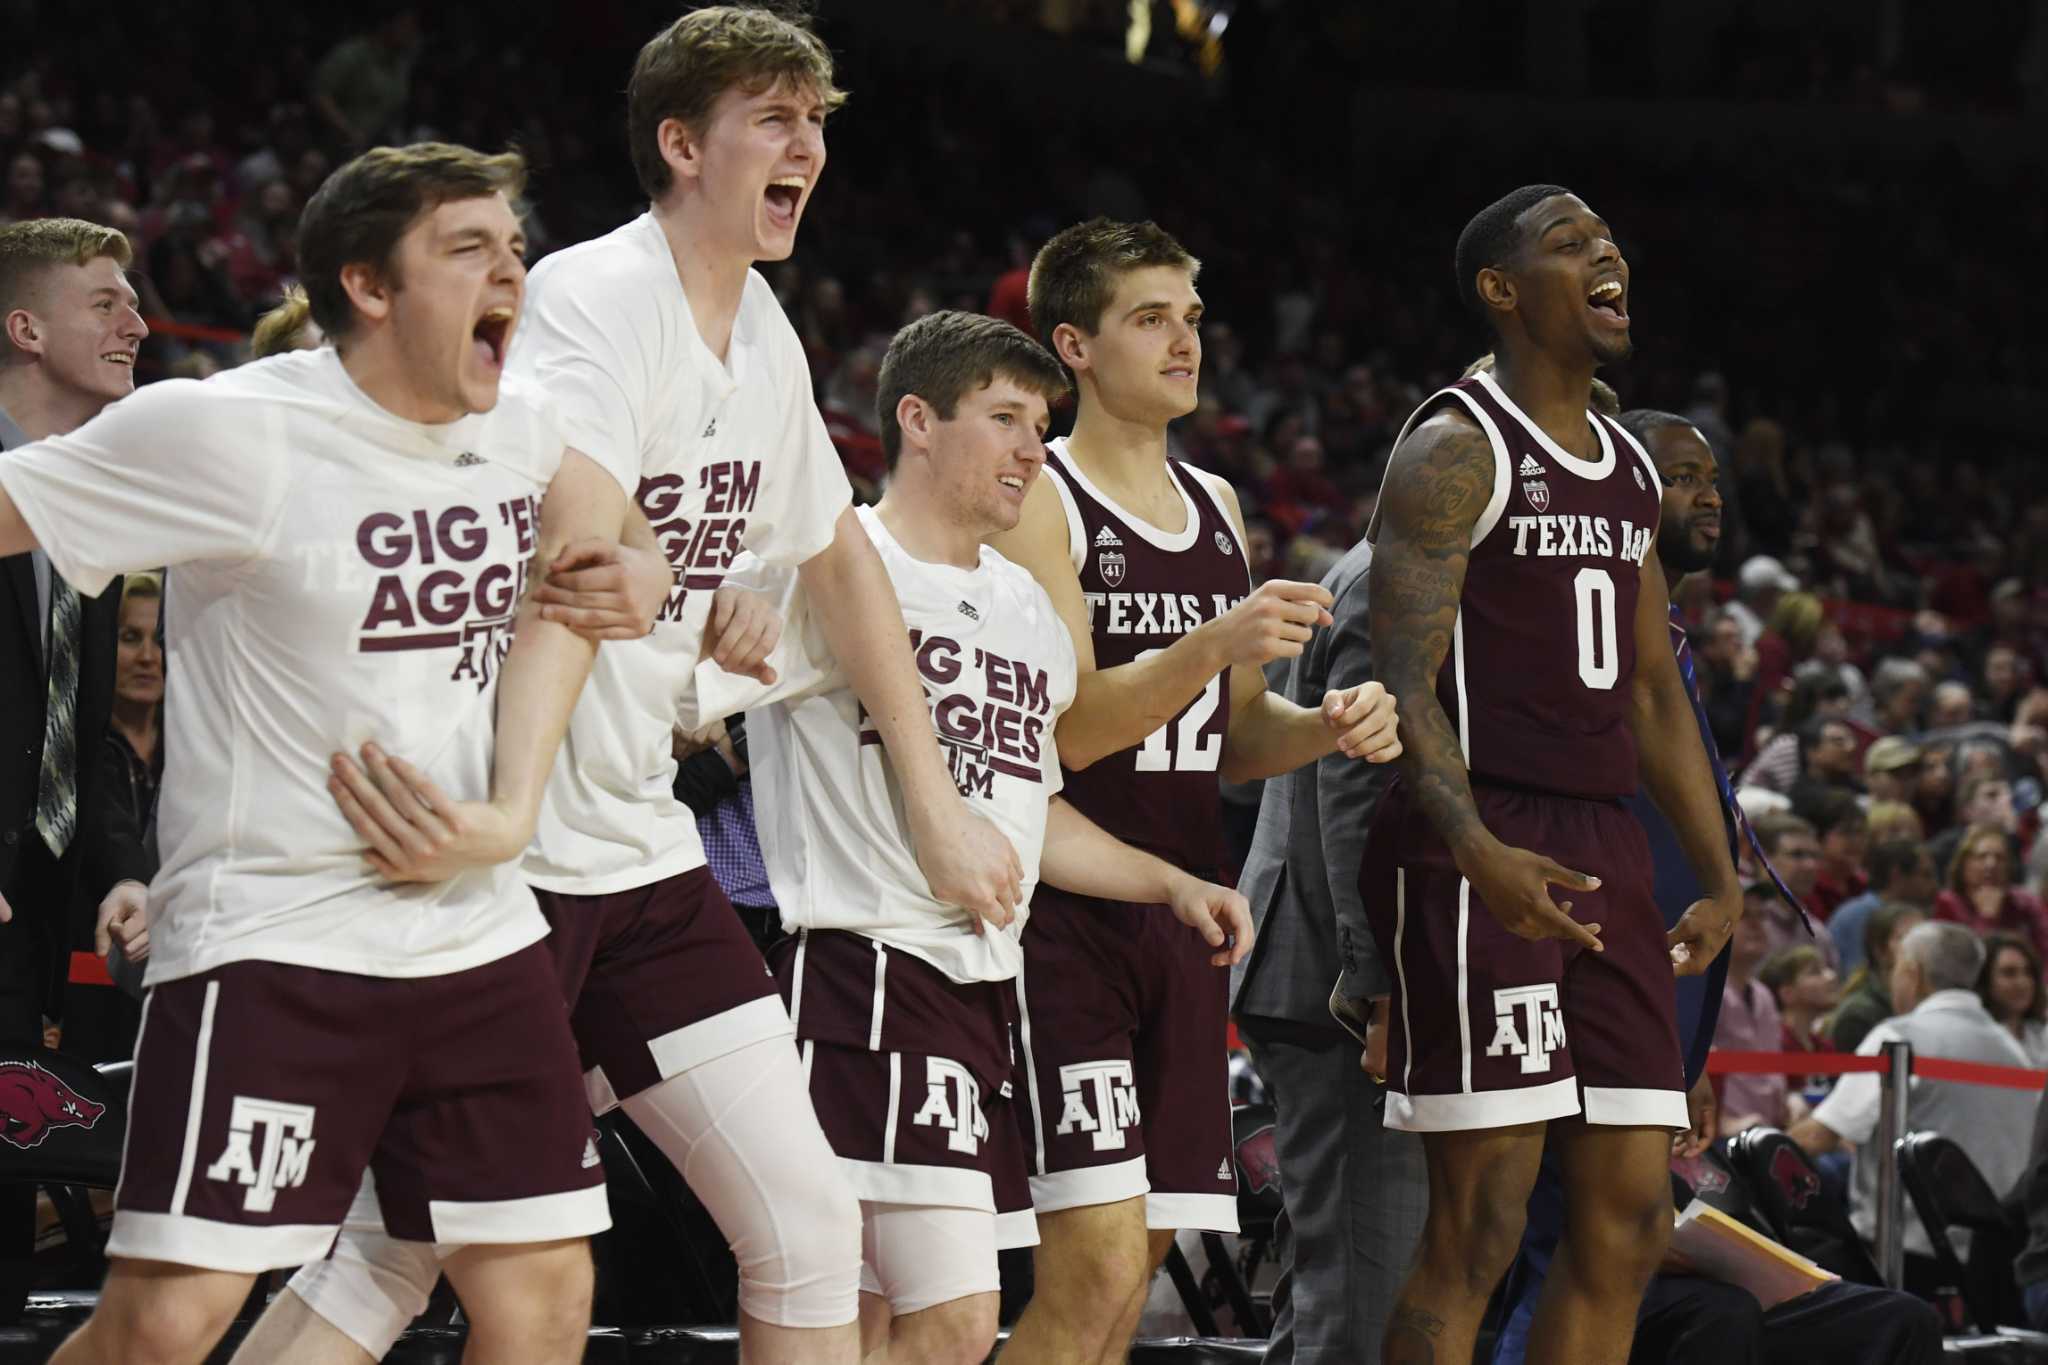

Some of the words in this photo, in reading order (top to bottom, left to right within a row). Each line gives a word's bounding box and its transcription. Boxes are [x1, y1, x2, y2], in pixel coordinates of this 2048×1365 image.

[1531, 491, 1546, 503] 41
[356, 505, 488, 569] GIG
[653, 517, 746, 570] GIES
[1509, 515, 1612, 558] TEXAS
[1104, 564, 1121, 577] 41
[1083, 592, 1202, 634] TEXAS
[1574, 567, 1618, 690] 0
[922, 686, 1043, 763] GIES
